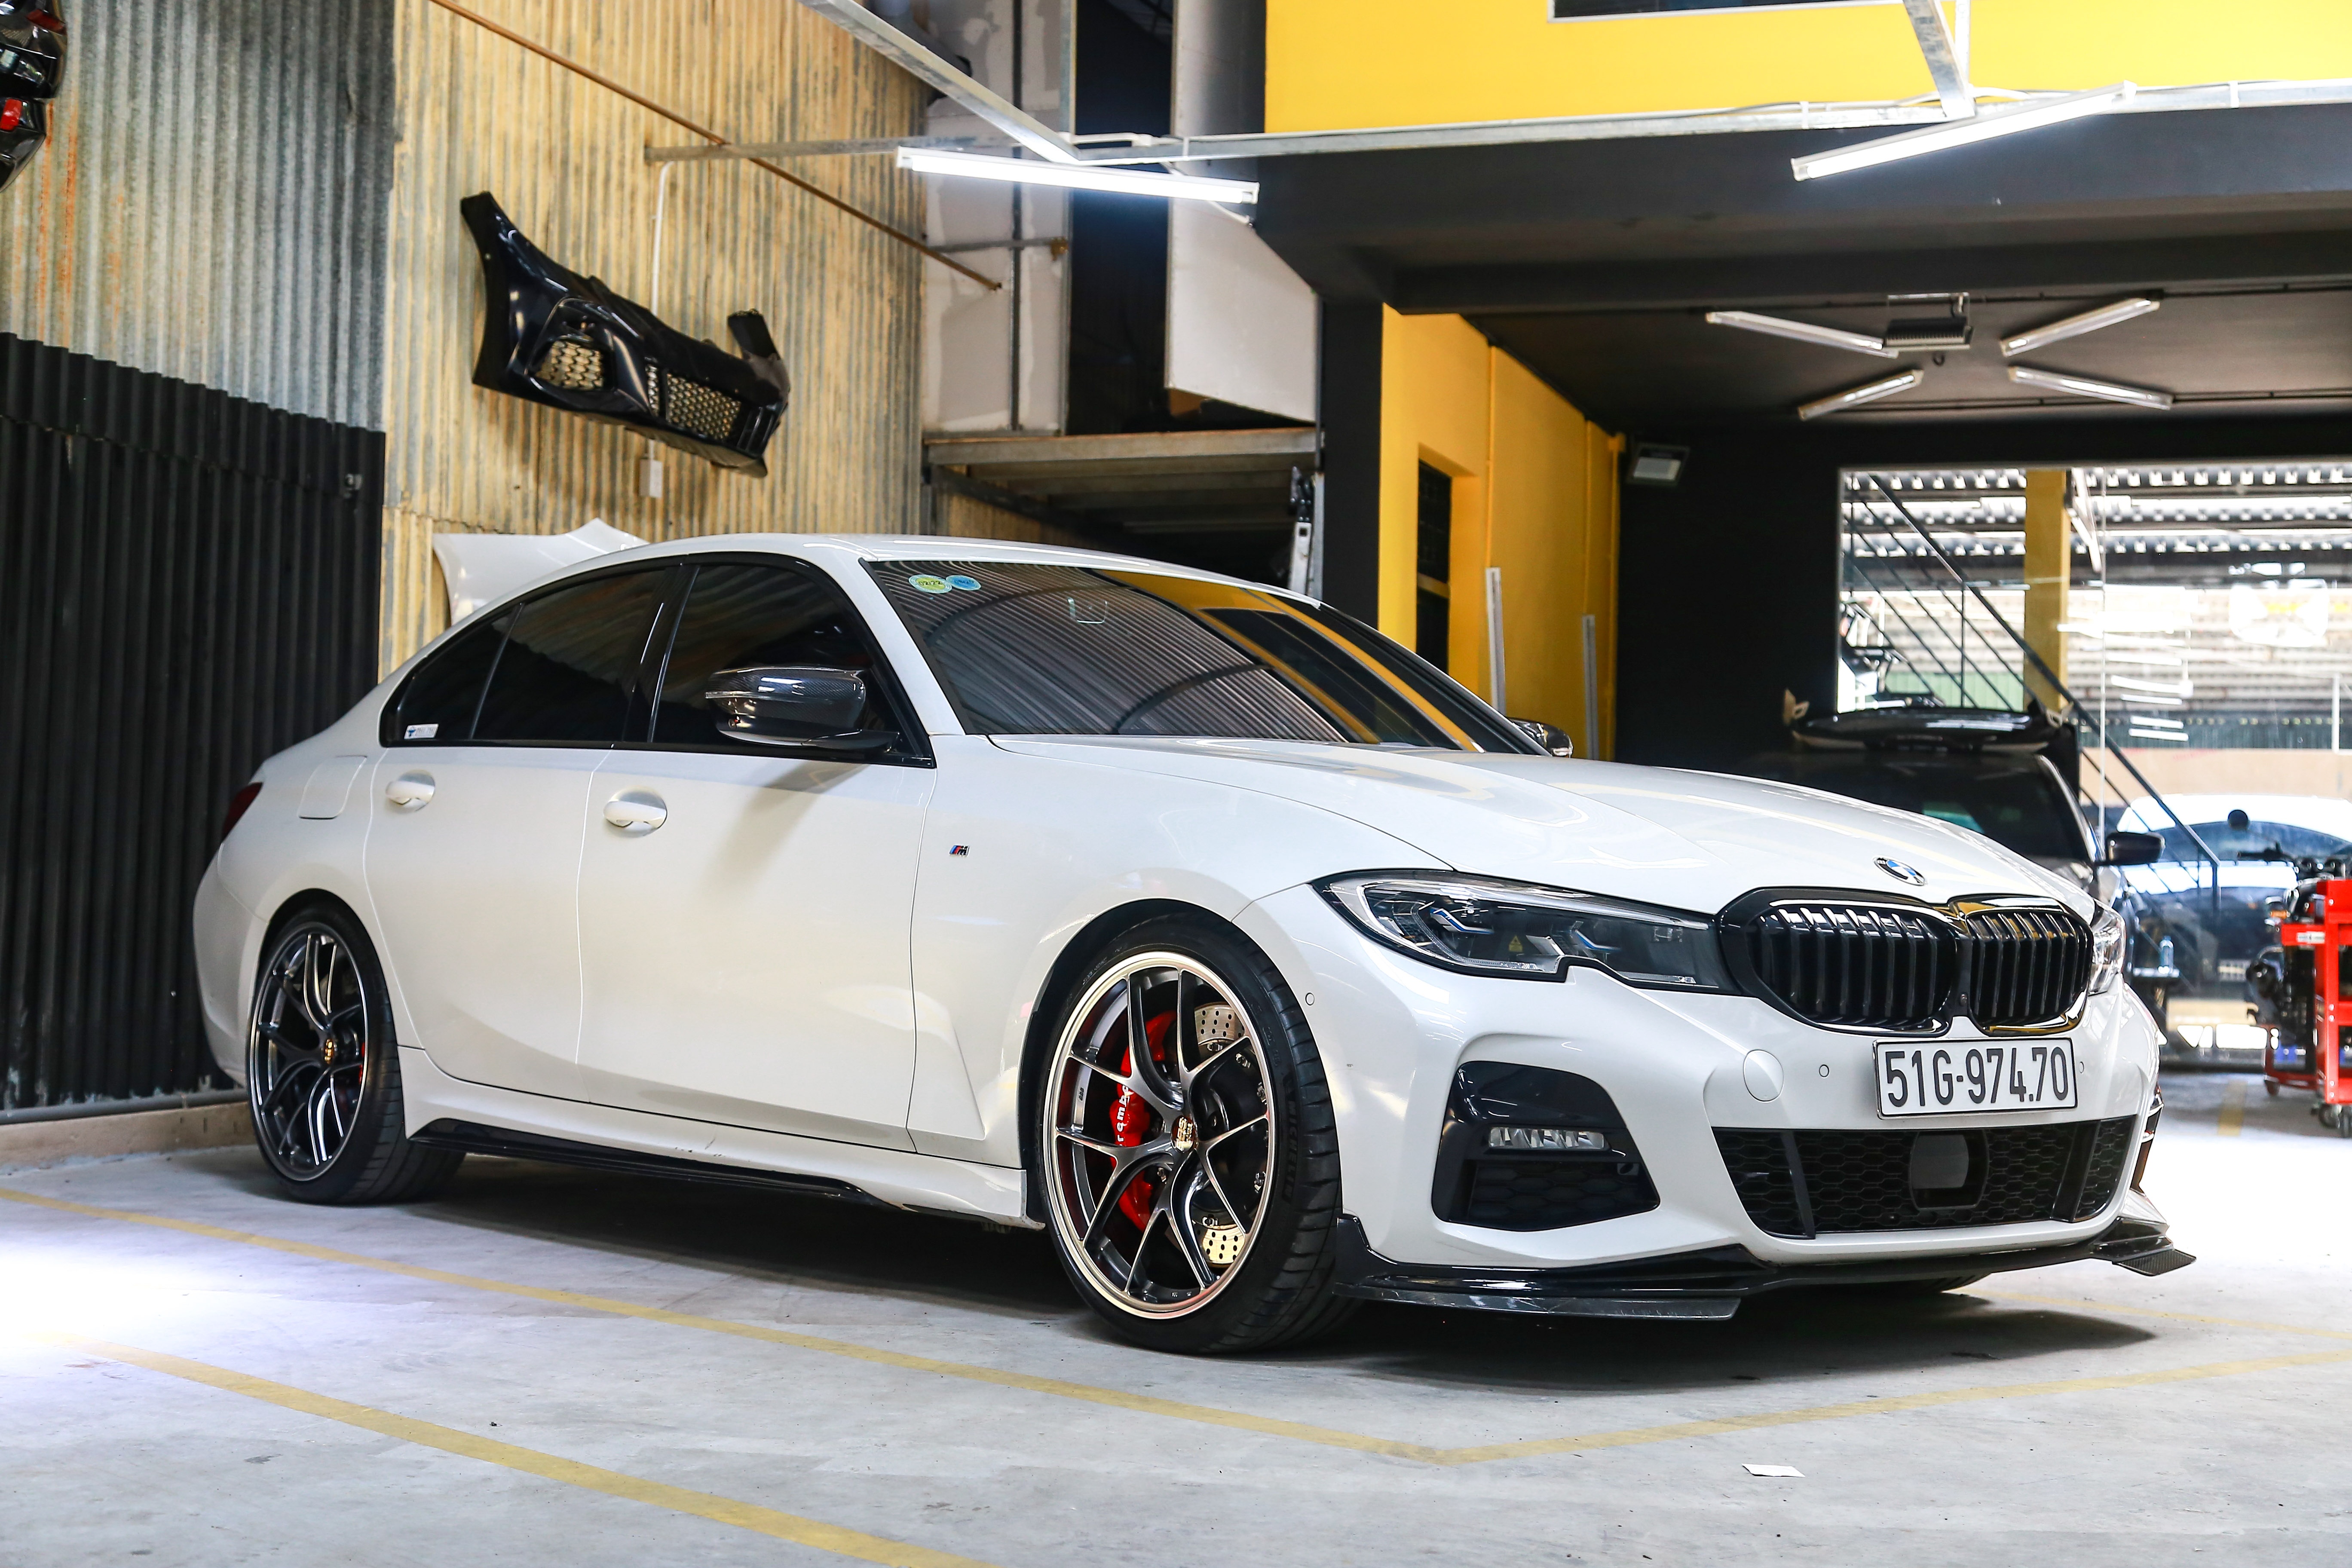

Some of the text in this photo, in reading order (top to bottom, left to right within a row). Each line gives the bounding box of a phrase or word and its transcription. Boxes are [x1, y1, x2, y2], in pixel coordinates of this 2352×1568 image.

[1885, 1046, 2069, 1107] 51G-974.70
[1116, 1085, 1130, 1146] rembo
[1284, 1100, 1298, 1198] MICHELIN
